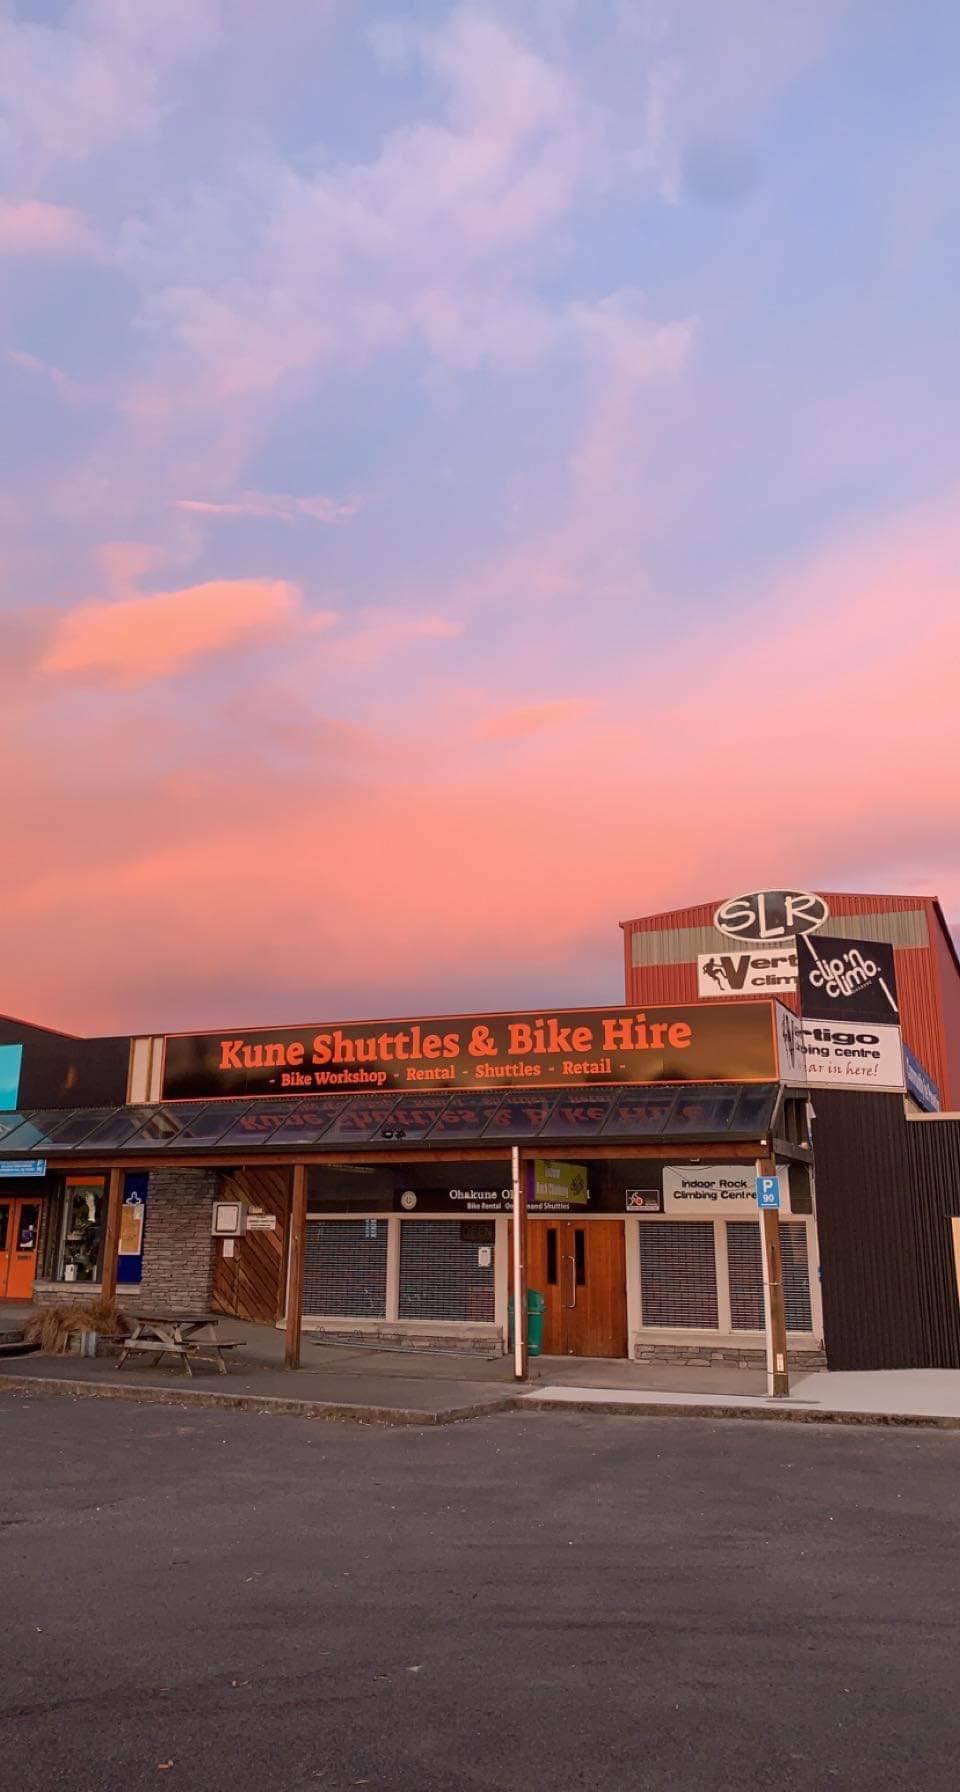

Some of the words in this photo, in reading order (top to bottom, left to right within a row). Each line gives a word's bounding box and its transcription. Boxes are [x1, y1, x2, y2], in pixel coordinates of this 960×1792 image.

[719, 894, 824, 939] SLR
[719, 954, 799, 990] Vert
[750, 975, 799, 986] clim
[219, 1040, 304, 1069] Kune
[312, 1026, 459, 1065] Shuttles
[467, 1025, 498, 1057] &
[507, 1018, 593, 1055] Bike
[602, 1013, 693, 1050] Hire
[834, 1047, 881, 1058] centre
[281, 1073, 311, 1087] Bike
[315, 1069, 387, 1086] Workshop
[406, 1065, 456, 1081] Rental
[475, 1061, 541, 1079] Shuttles
[562, 1058, 612, 1074] Retail
[681, 1179, 716, 1189] Indoor
[719, 1180, 748, 1189] Rock
[763, 1179, 773, 1192] P
[449, 1190, 498, 1200] Ohakune
[673, 1190, 718, 1201] Climbing
[720, 1190, 757, 1200] Centre
[762, 1195, 775, 1203] 90
